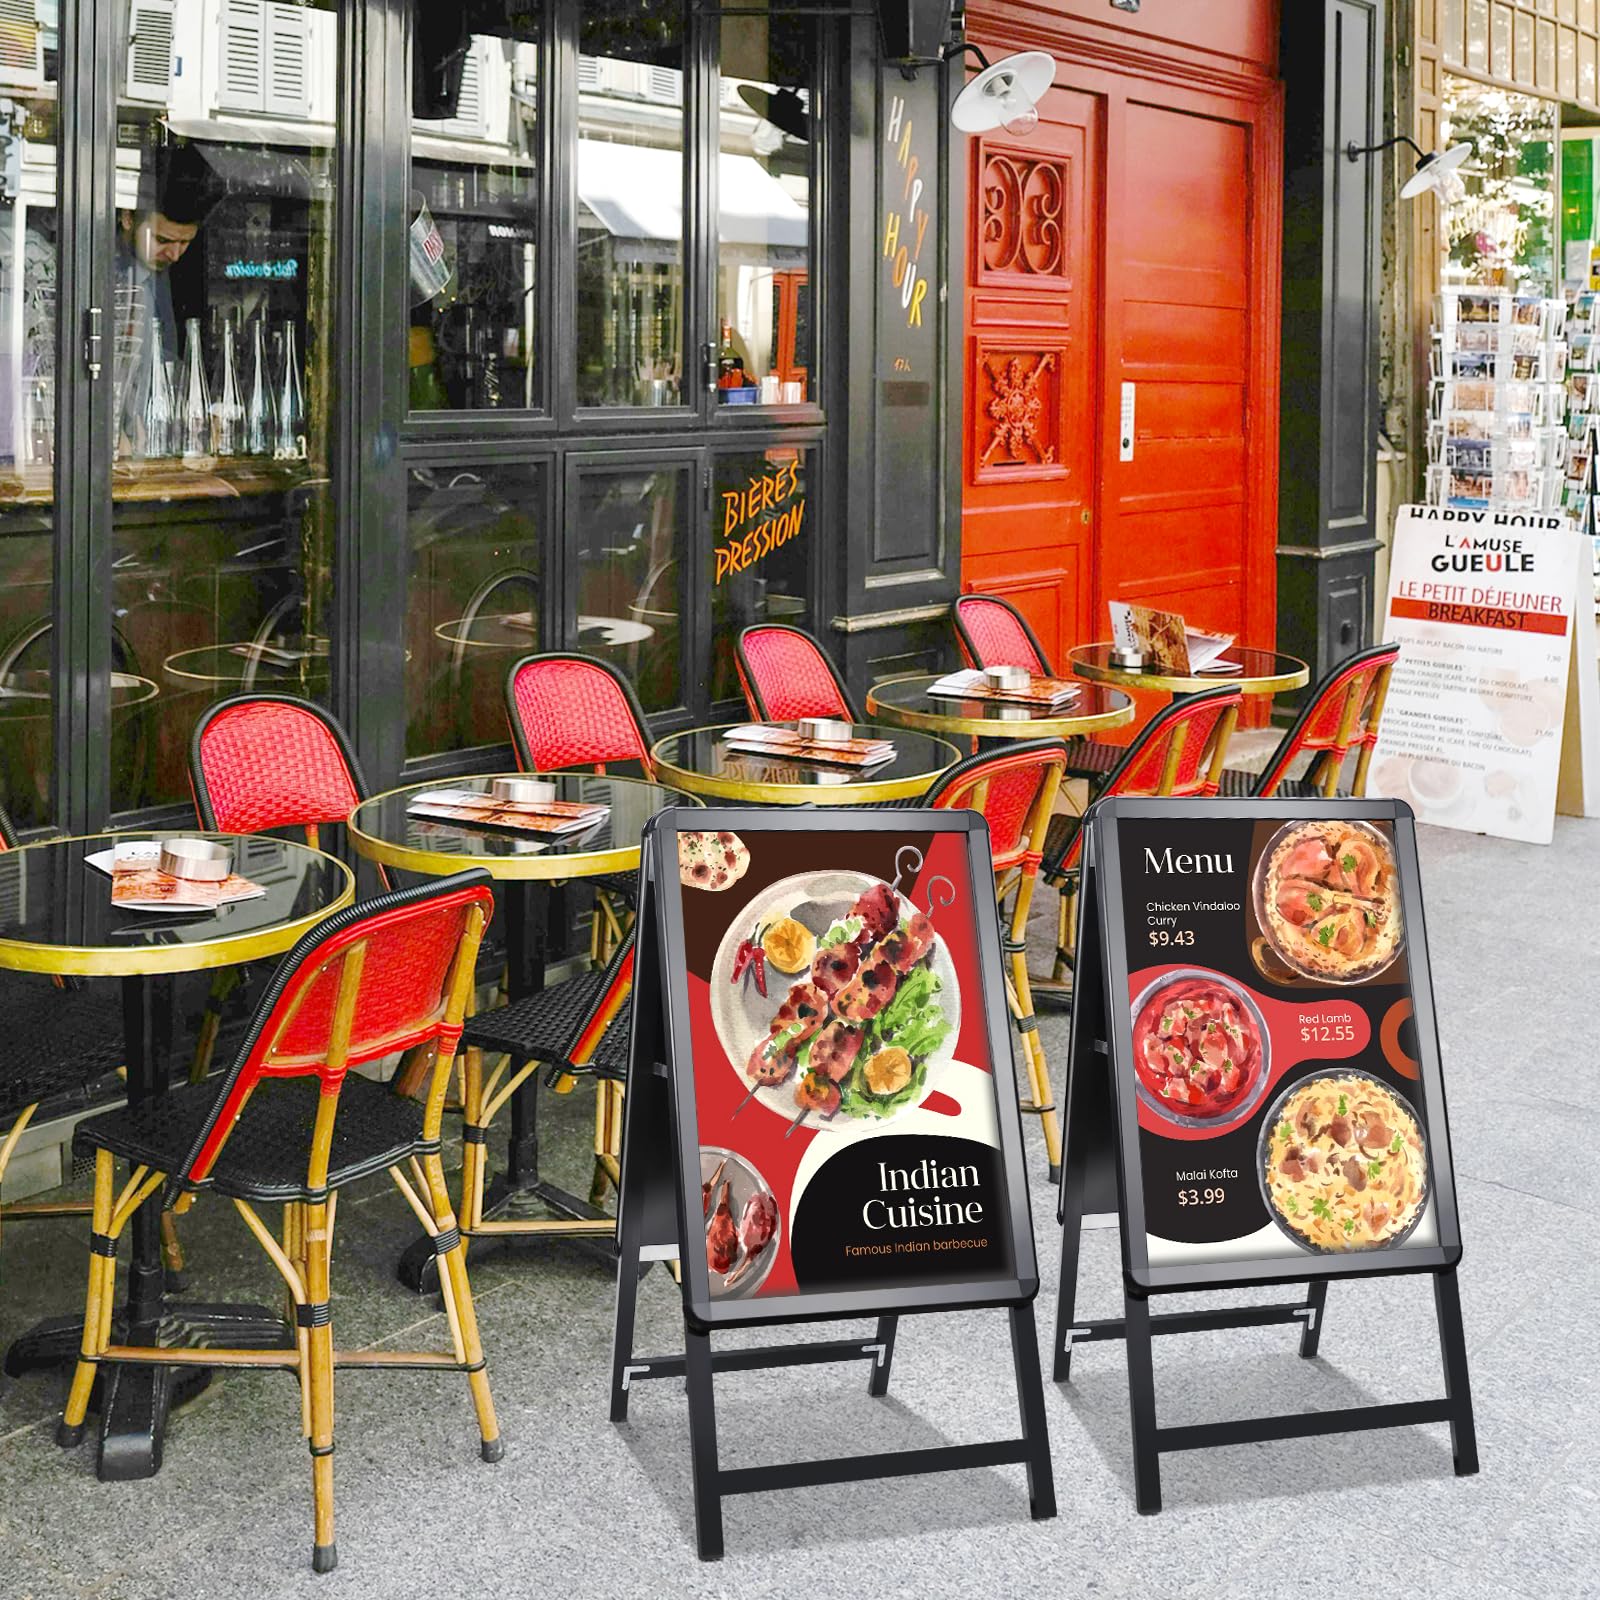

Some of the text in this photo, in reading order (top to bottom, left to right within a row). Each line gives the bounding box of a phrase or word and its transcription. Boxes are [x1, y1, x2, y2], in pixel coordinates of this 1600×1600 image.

[887, 95, 928, 261] HAPPY
[883, 211, 928, 328] HOUR
[722, 459, 798, 537] BIÈRES
[714, 499, 805, 585] PRESSION
[1431, 554, 1534, 572] GUEULE
[1399, 580, 1562, 613] LE PETIT DÉJEUNER
[1428, 603, 1529, 629] BREAKFAST
[1143, 847, 1235, 874] Menu
[1146, 900, 1241, 912] Chicken Vindaloo
[1147, 916, 1177, 928] Curry
[1149, 930, 1195, 947] $9.43
[1298, 1013, 1352, 1024] Red Lamb
[1300, 1025, 1355, 1043] $12.55
[877, 1159, 981, 1192] Indian
[1176, 1167, 1238, 1182] Malai Kofta
[1177, 1188, 1225, 1206] $3.99
[862, 1196, 984, 1230] Cuisine
[845, 1237, 988, 1257] Famous Indian barbecue
